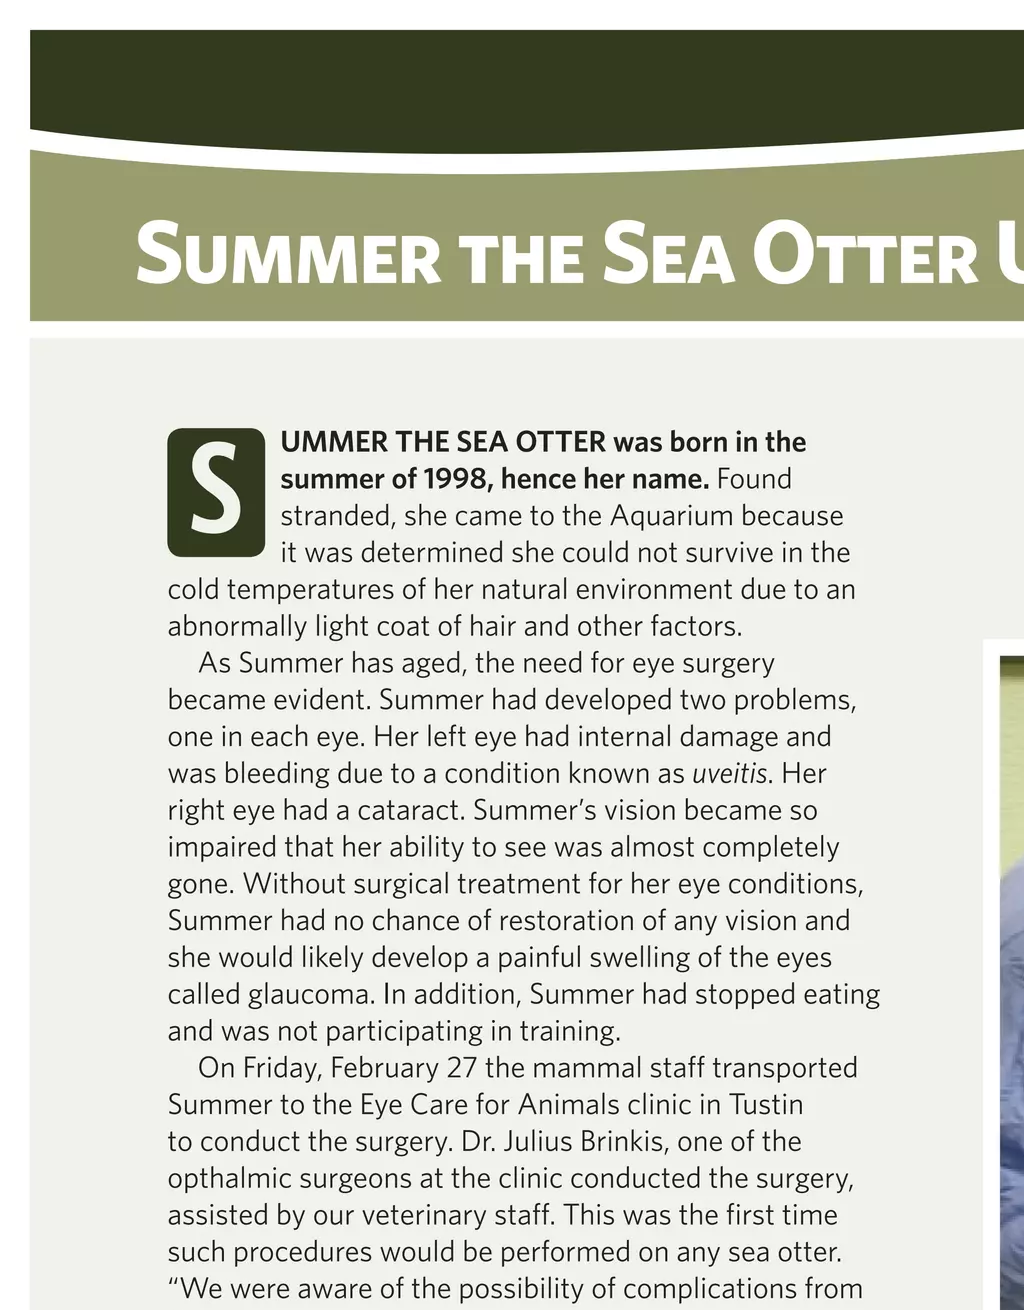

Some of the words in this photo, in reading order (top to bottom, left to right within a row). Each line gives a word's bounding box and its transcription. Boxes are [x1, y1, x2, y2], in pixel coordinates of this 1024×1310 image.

[191, 442, 240, 534] S
[282, 430, 388, 452] UMMER
[395, 430, 449, 452] THE
[457, 430, 508, 452] SEA
[516, 430, 606, 452] OTTER
[613, 436, 662, 452] was
[671, 430, 727, 452] born
[736, 430, 757, 452] in
[765, 430, 806, 452] the
[281, 473, 385, 489] summer
[392, 467, 417, 489] of
[424, 467, 493, 493] 1998,
[502, 466, 576, 489] hence
[585, 466, 625, 489] her
[633, 473, 709, 489] name.
[719, 467, 791, 489] Found
[281, 503, 396, 529] stranded,
[405, 503, 447, 526] she
[456, 510, 522, 526] came
[530, 506, 554, 526] to
[562, 504, 601, 526] the
[610, 504, 732, 531] Aquarium
[743, 503, 843, 526] because
[168, 768, 216, 784] was
[226, 761, 330, 789] bleeding
[338, 761, 382, 784] due
[391, 763, 415, 784] to
[424, 768, 436, 783] a
[445, 761, 559, 784] condition
[570, 761, 649, 783] known
[658, 768, 684, 783] as
[693, 762, 772, 783] uveitis.
[783, 762, 827, 783] Her
[199, 1056, 234, 1078] On
[245, 1056, 322, 1083] Friday,
[332, 1056, 439, 1083] February
[448, 1056, 477, 1078] 27
[485, 1056, 524, 1078] the
[534, 1056, 640, 1078] mammal
[651, 1055, 705, 1078] staff
[713, 1056, 857, 1083] transported
